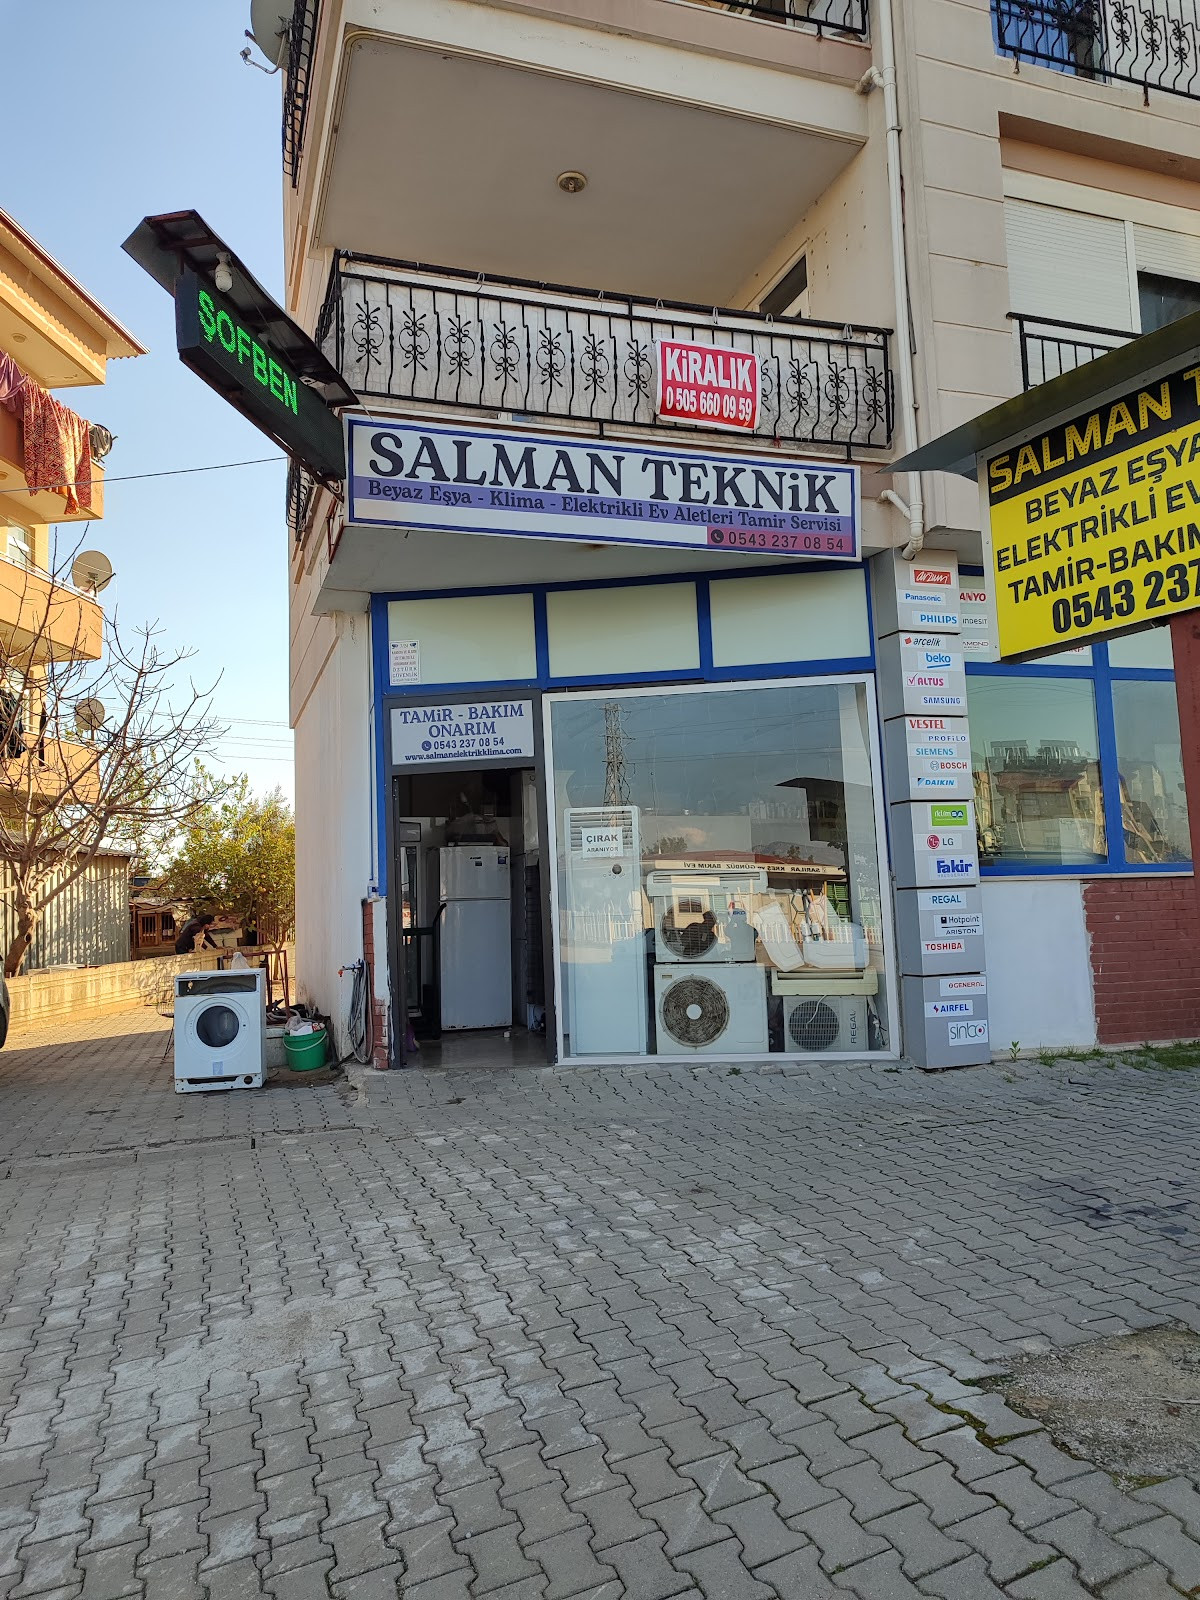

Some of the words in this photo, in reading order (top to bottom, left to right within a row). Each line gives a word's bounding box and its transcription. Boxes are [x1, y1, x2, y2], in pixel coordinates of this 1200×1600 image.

[198, 290, 298, 415] ŞOFBEN
[665, 386, 674, 410] 0
[676, 387, 697, 413] 505
[699, 391, 720, 417] 660
[722, 394, 736, 419] 09
[738, 397, 753, 421] 59
[990, 381, 1171, 494] SALMAN
[369, 431, 625, 497] SALMAN
[1026, 466, 1119, 525] BEYAZ
[368, 479, 423, 500] Beyaz
[429, 485, 472, 506] Eşya
[489, 490, 545, 510] Klima
[561, 496, 643, 518] Elektrikli
[649, 503, 669, 520] Ev
[673, 506, 734, 525] Aletleri
[738, 511, 786, 529] Tamir
[790, 515, 842, 532] Servisi
[996, 486, 1157, 572] ELEKTRİKLİ
[728, 531, 766, 547] 0543
[771, 534, 797, 549] 237
[803, 536, 821, 550] 08
[826, 537, 844, 551] 54
[905, 593, 942, 602] Panasonic
[960, 592, 987, 602] ANYO
[1052, 578, 1136, 634] 0543
[920, 614, 957, 624] PHILIPS
[913, 638, 941, 648] arçelik
[925, 652, 951, 663] beko
[917, 677, 944, 686] ALTUS
[468, 703, 524, 720] BAKIM
[428, 721, 496, 738] ONARIM
[909, 719, 946, 729] VESTEL
[433, 740, 457, 750] 0543
[459, 738, 476, 748] 237
[479, 738, 490, 746] 08
[493, 737, 504, 746] 54
[404, 747, 522, 761] www.salmanelektrikklima.com
[915, 748, 954, 756] SIEMENS
[586, 834, 619, 844] ÇIRAK
[936, 859, 973, 874] Fakir
[931, 894, 962, 904] REGAL
[948, 915, 980, 925] Hotpoint
[925, 942, 962, 951] TOSHIBA
[940, 1003, 969, 1012] AIRFEL
